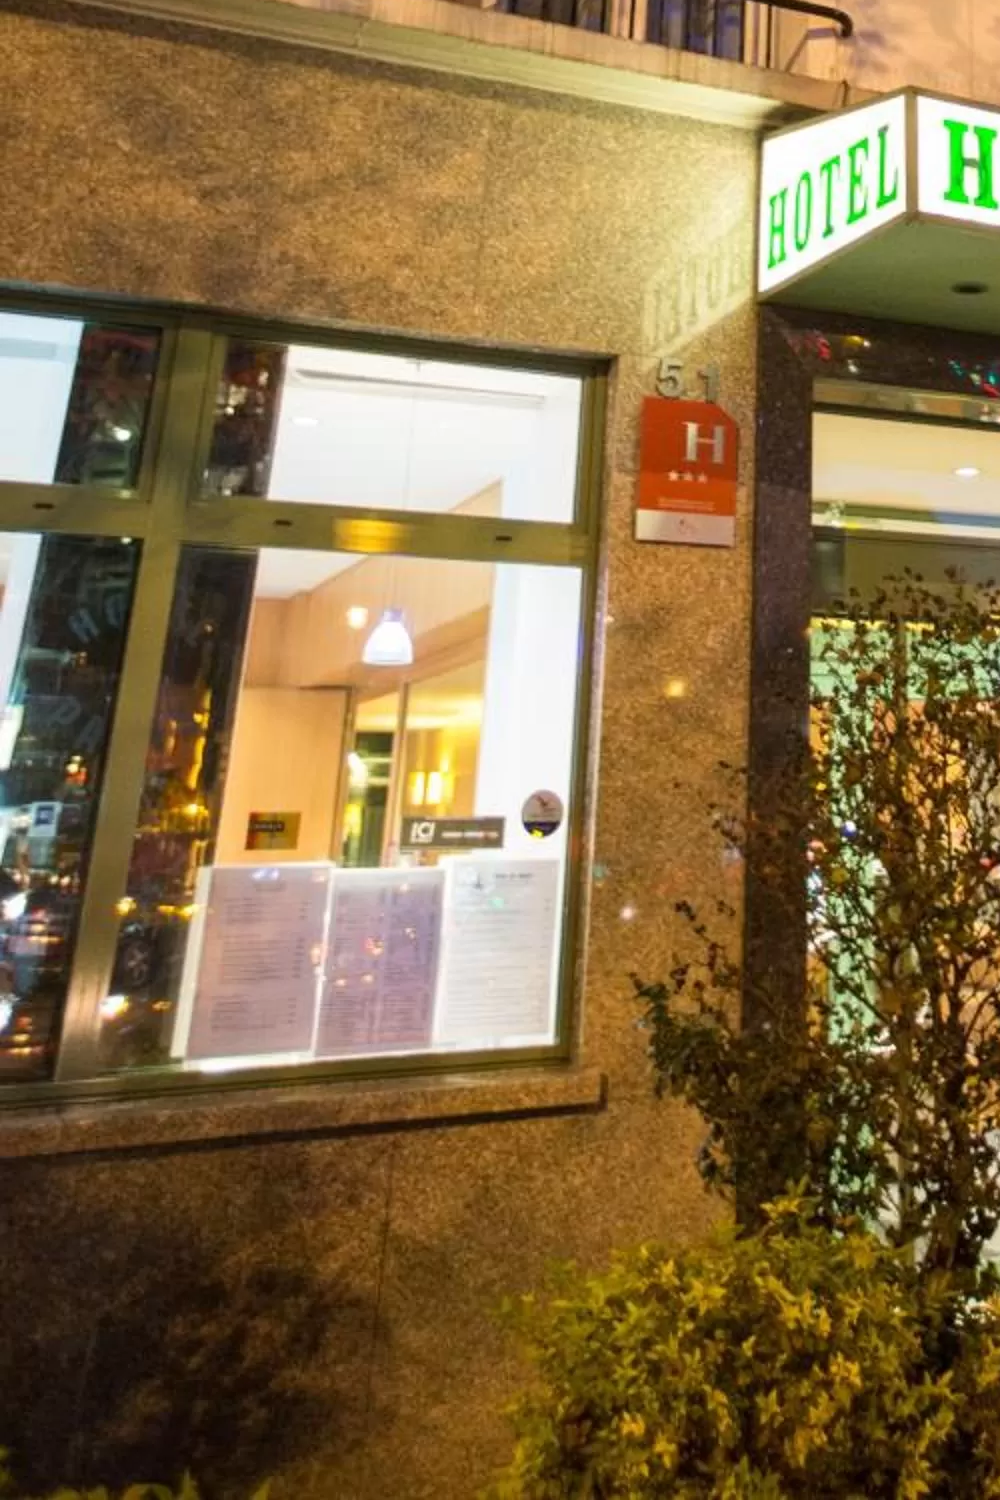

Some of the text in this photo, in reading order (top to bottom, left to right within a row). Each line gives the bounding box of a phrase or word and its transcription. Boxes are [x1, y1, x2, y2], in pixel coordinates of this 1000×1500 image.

[767, 124, 899, 269] HOTEL
[656, 358, 722, 404] 51
[682, 421, 725, 463] H
